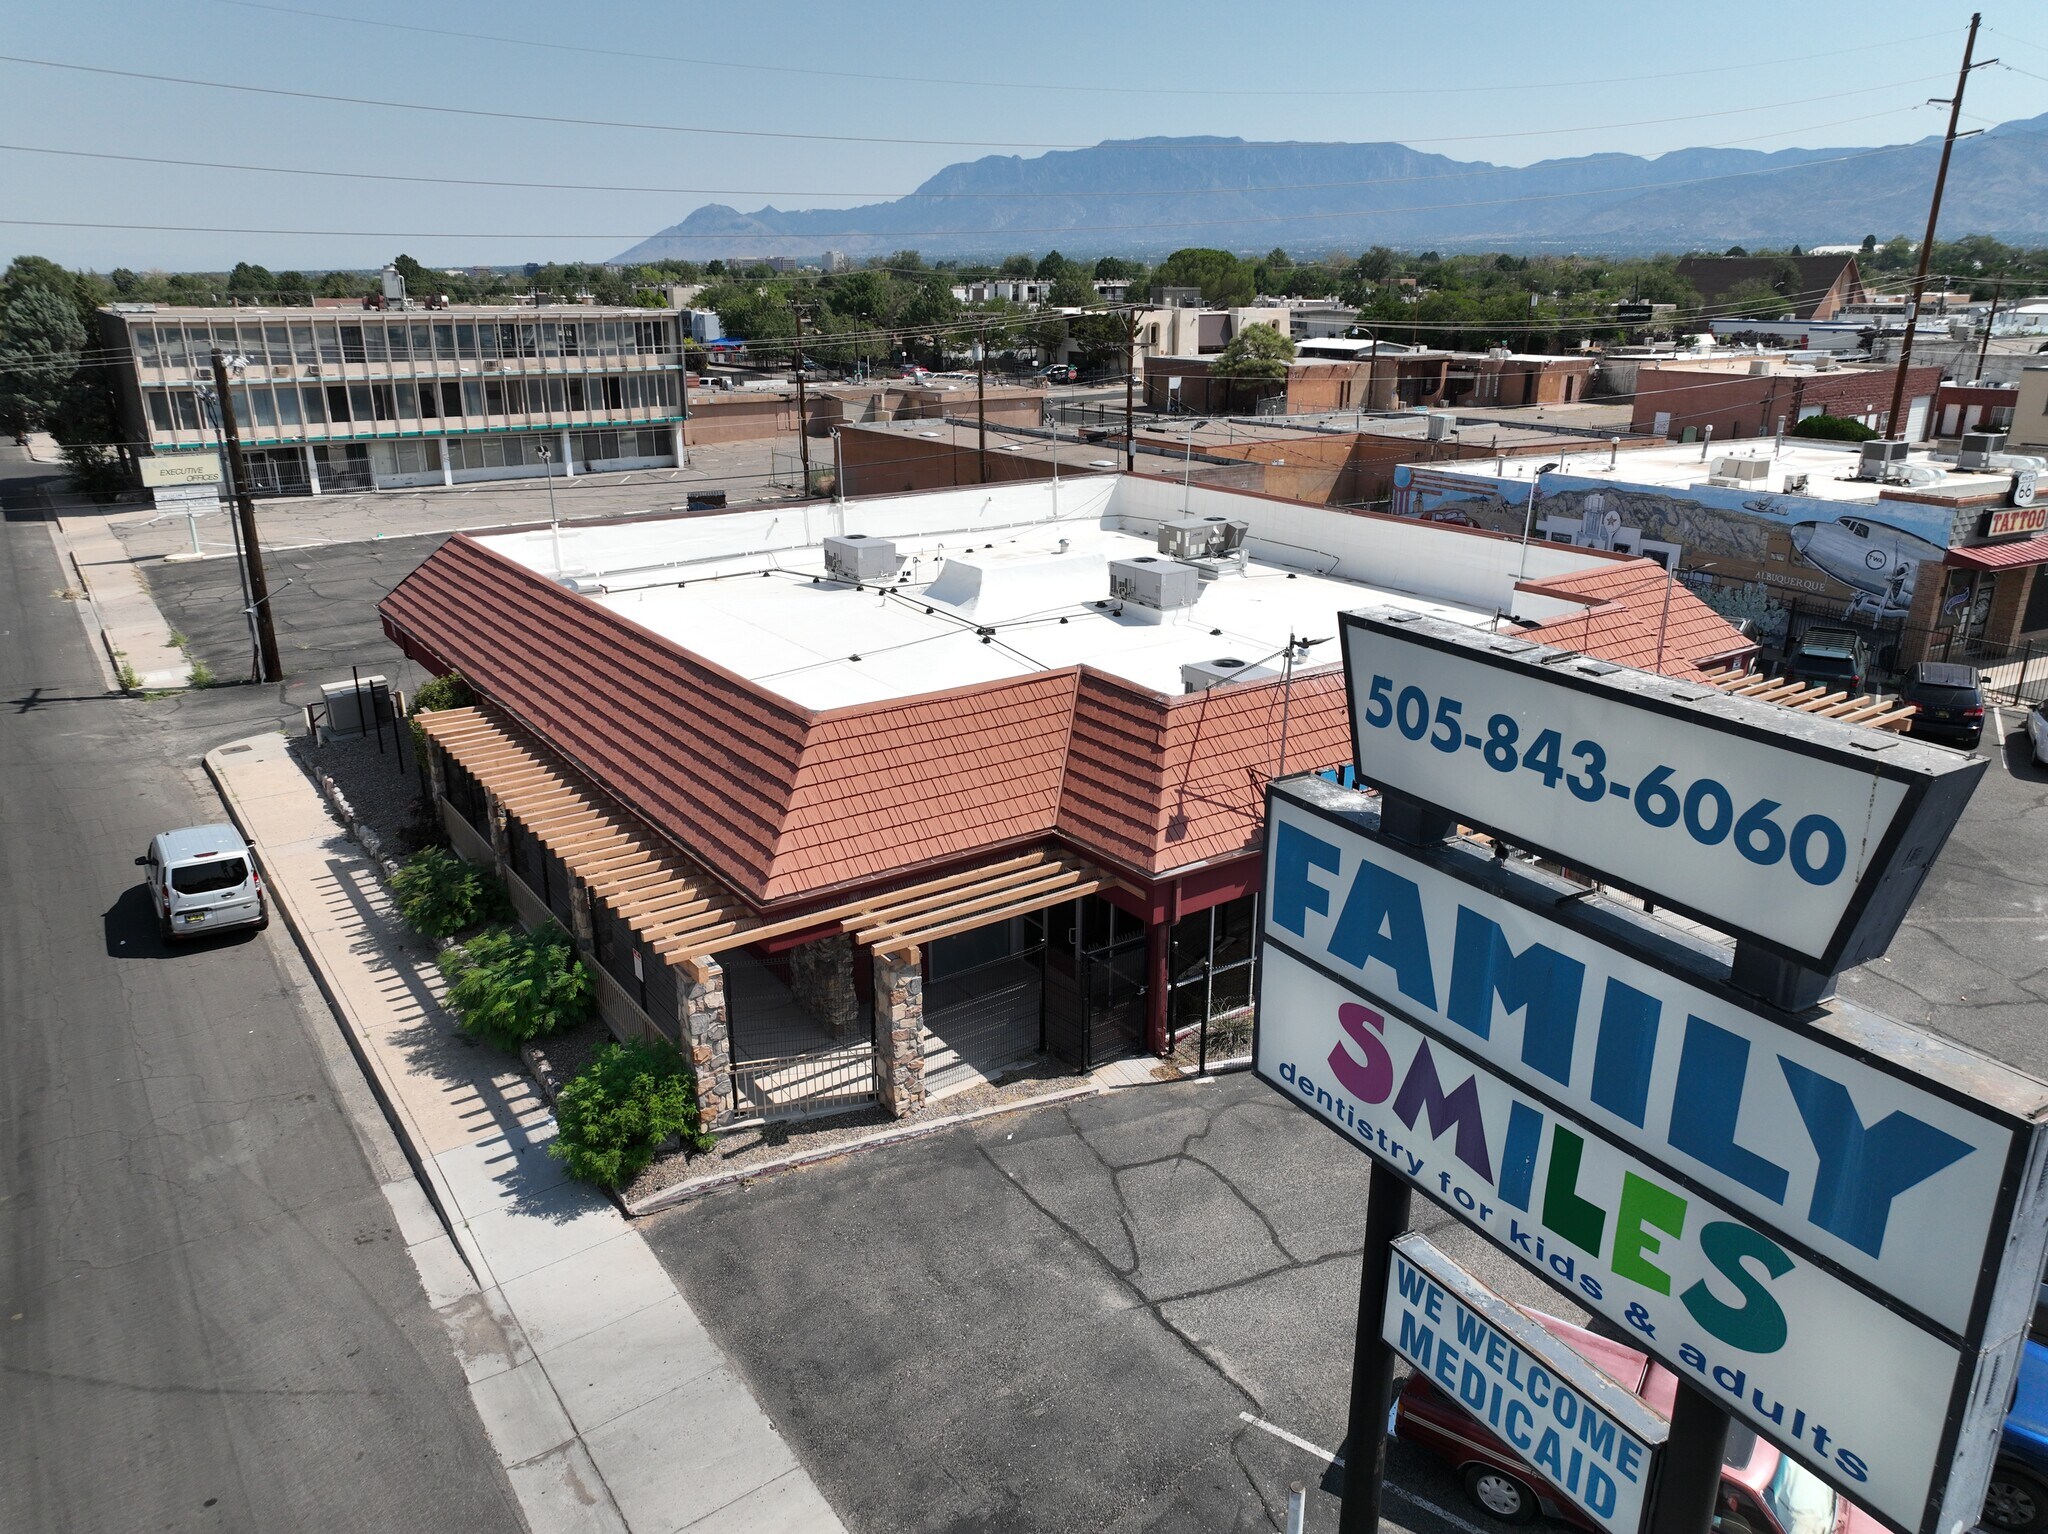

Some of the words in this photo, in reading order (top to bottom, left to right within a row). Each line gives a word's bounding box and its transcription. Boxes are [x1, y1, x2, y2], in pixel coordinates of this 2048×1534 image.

[160, 467, 203, 476] EXECUTIVE
[186, 474, 219, 482] OFFICES
[1992, 508, 2047, 533] TATTOO
[2018, 484, 2032, 499] 66
[1754, 571, 1826, 592] ALBUQUERQUE
[1868, 555, 1883, 564] TWA
[1366, 675, 1847, 886] 505-843-6060
[1273, 820, 1977, 1260] FAMILY
[1327, 1002, 1797, 1354] SMILES
[1279, 1062, 1425, 1177] dentistry
[1439, 1171, 1494, 1222] for
[1510, 1218, 1604, 1301] kids
[1624, 1301, 1657, 1341] &
[1678, 1342, 1869, 1483] adults
[1397, 1259, 1445, 1325] WE
[1456, 1305, 1642, 1484] WELCOME
[1399, 1309, 1617, 1520] MEDICAID
